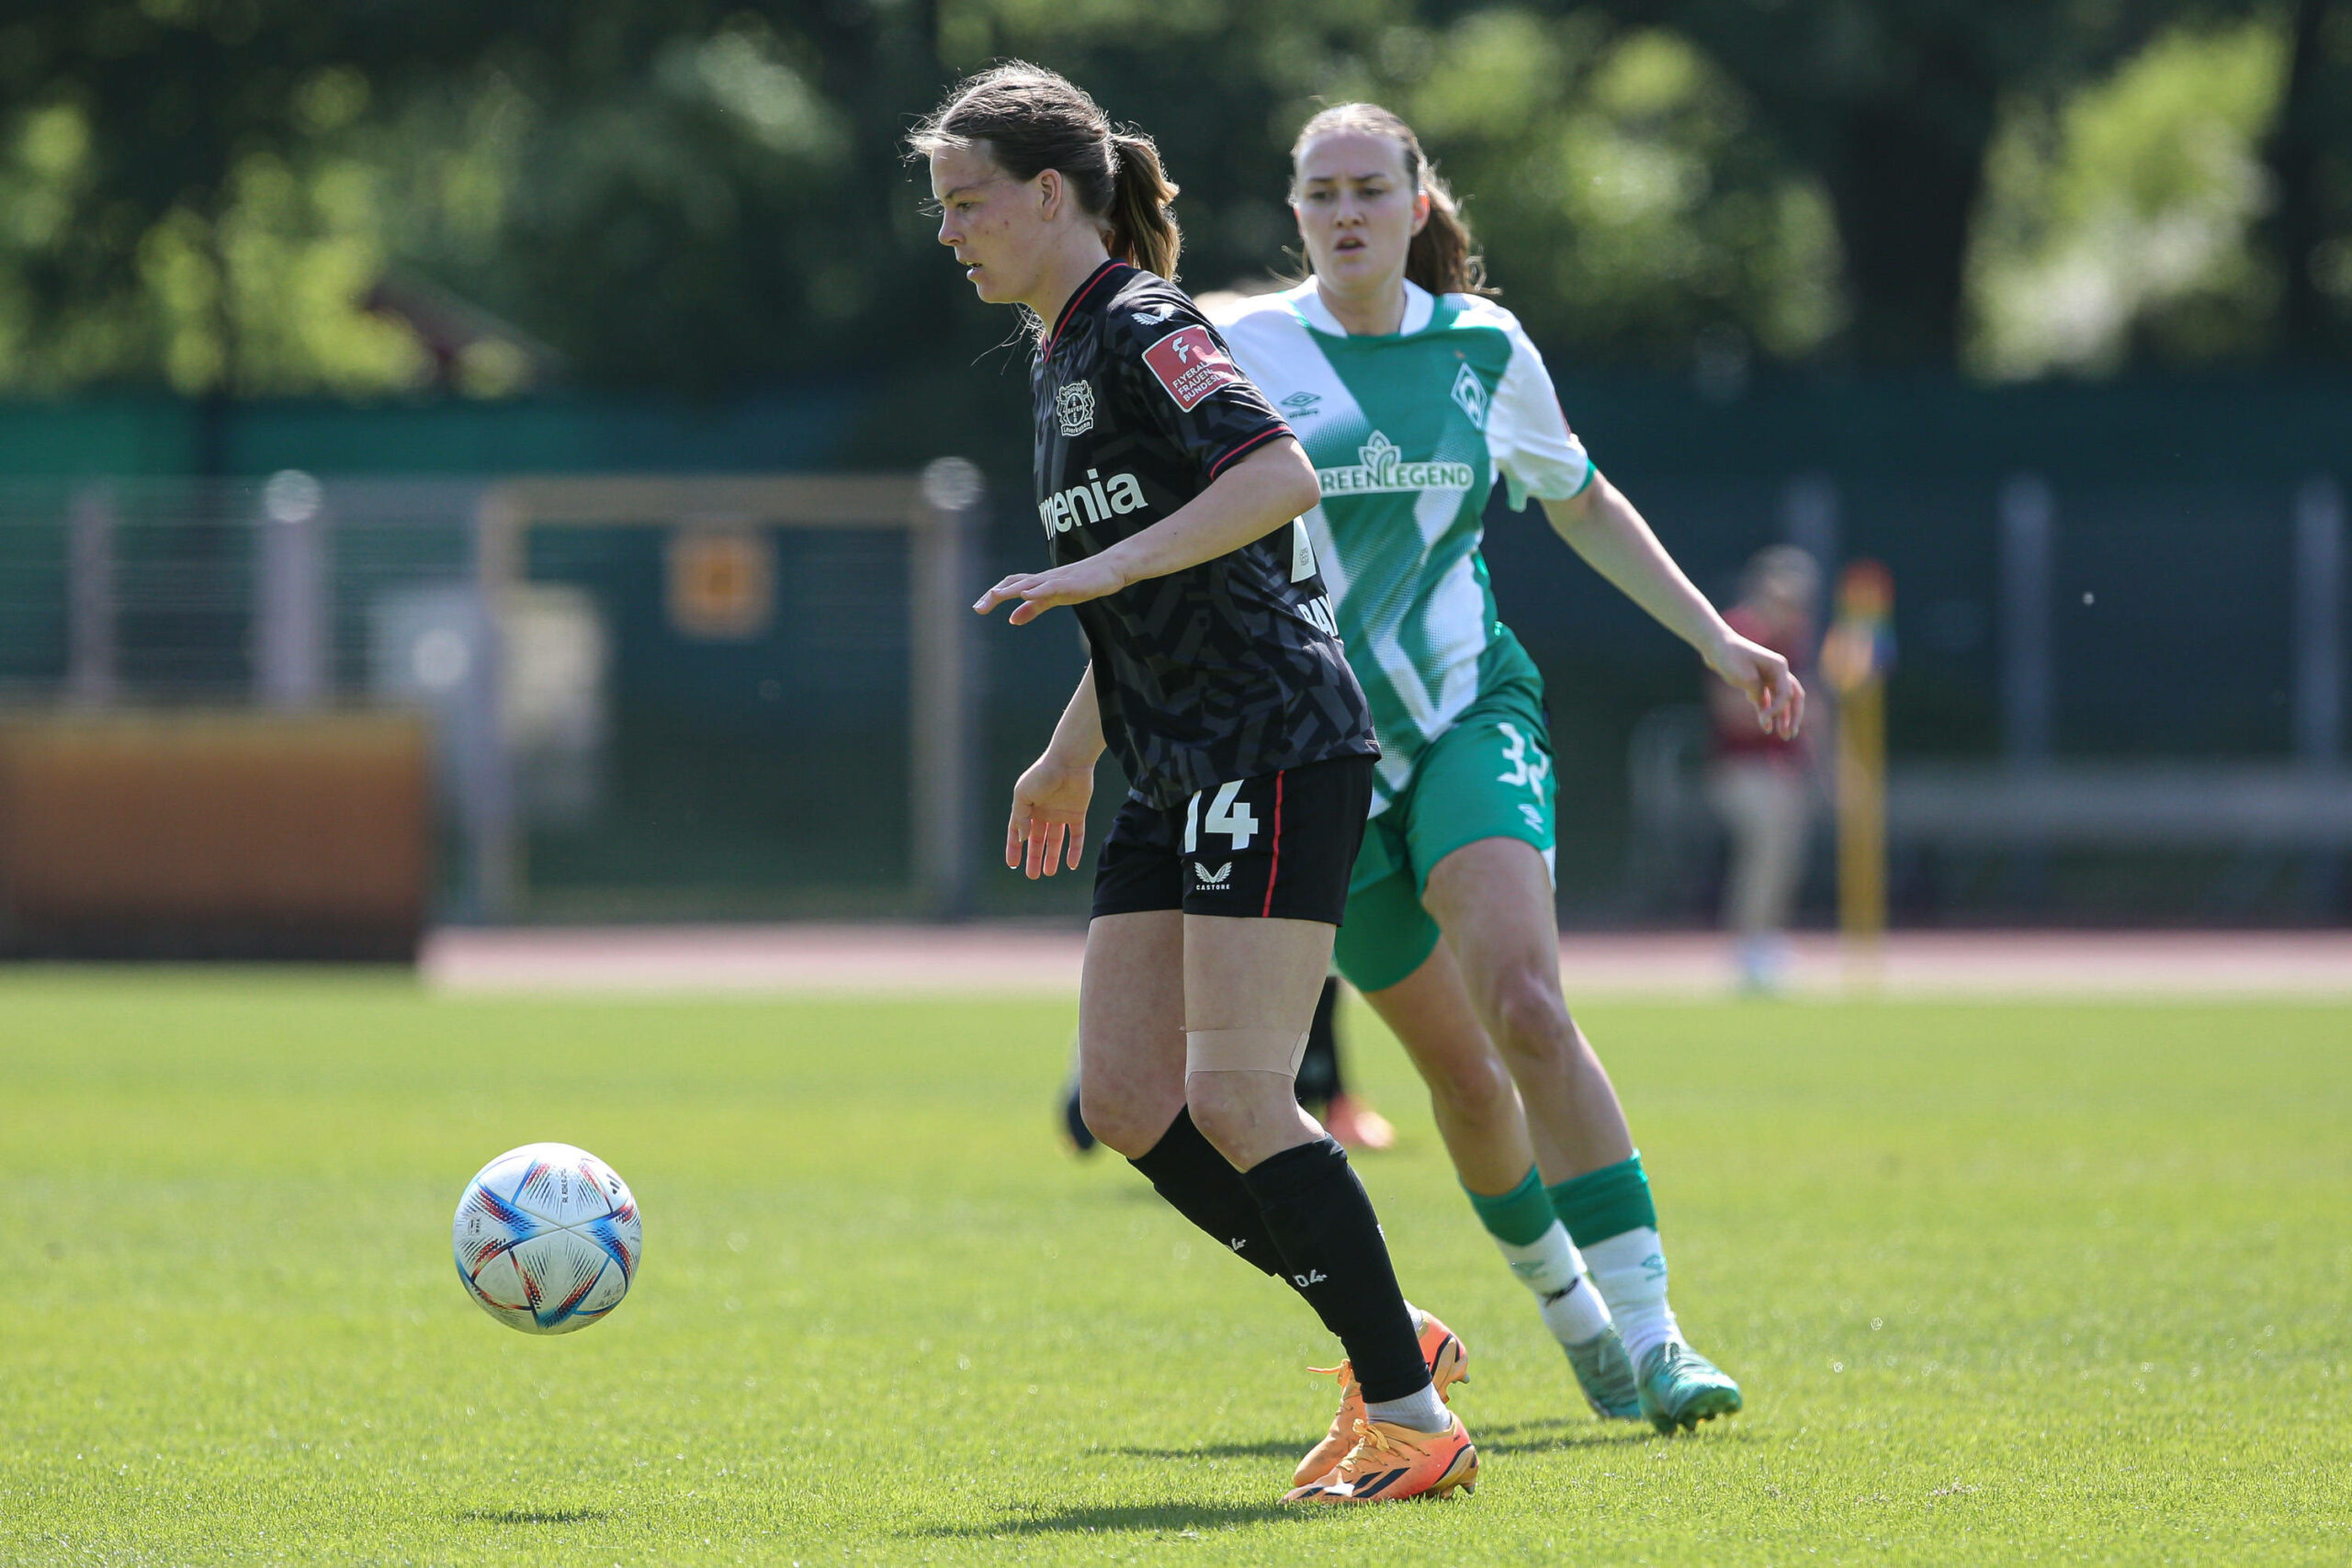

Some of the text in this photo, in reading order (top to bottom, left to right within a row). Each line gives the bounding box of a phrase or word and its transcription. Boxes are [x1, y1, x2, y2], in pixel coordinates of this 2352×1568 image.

[1172, 361, 1213, 389] FLYERAL
[1183, 374, 1223, 402] BUNDESL
[1320, 461, 1470, 491] REENLEGEND
[1184, 779, 1259, 853] 14
[1294, 1269, 1329, 1288] 04
